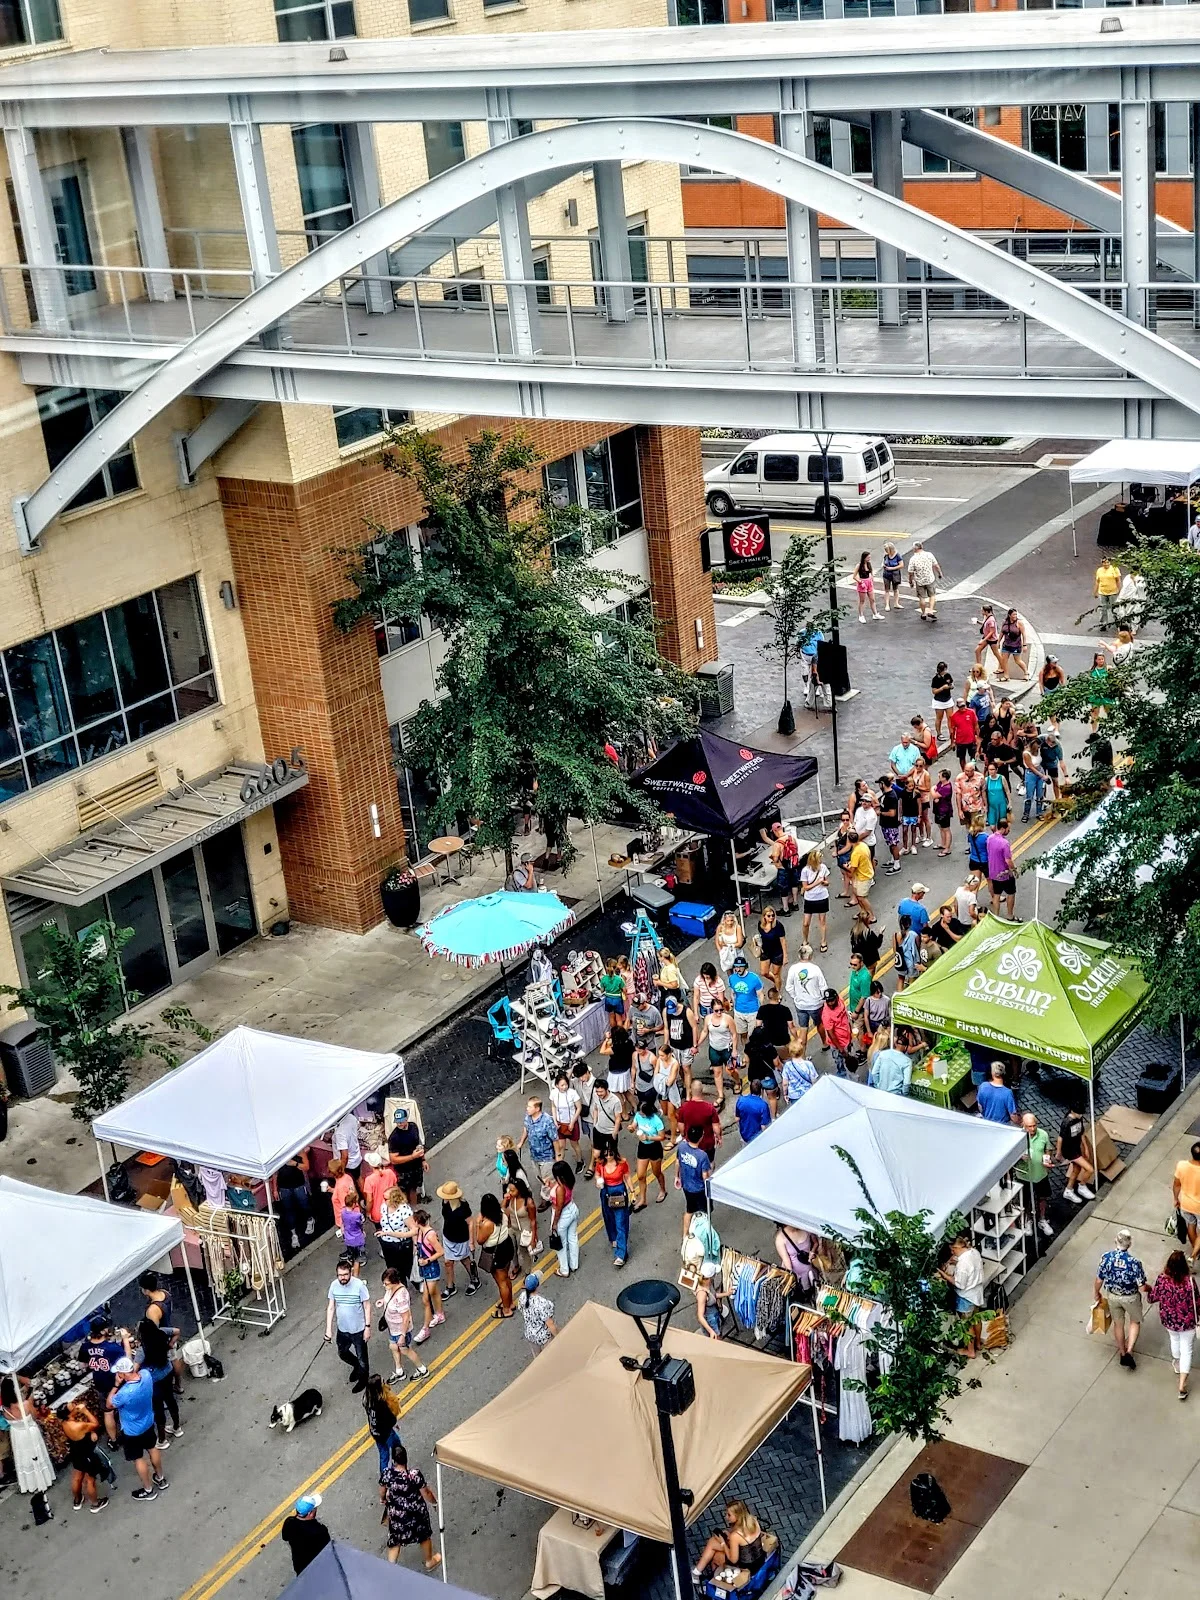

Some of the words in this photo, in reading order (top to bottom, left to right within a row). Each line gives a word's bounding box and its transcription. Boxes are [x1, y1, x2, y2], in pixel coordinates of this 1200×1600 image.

[728, 555, 770, 565] SWEETWATERS
[240, 746, 305, 804] 6605
[643, 777, 706, 793] SWEETWATERS
[720, 756, 764, 788] SWEETWATERS
[249, 791, 279, 814] STREET
[968, 968, 1052, 1010] DUBLIN
[1068, 955, 1120, 1002] DUBLIN
[1090, 988, 1110, 1008] IRISH
[1106, 968, 1129, 990] FESTIVAL
[963, 989, 994, 1003] IRISH
[995, 997, 1046, 1017] FESTIVAL
[956, 1020, 980, 1035] First
[980, 1027, 1030, 1049] Weekend
[1045, 1046, 1086, 1065] August
[88, 1357, 110, 1372] 48
